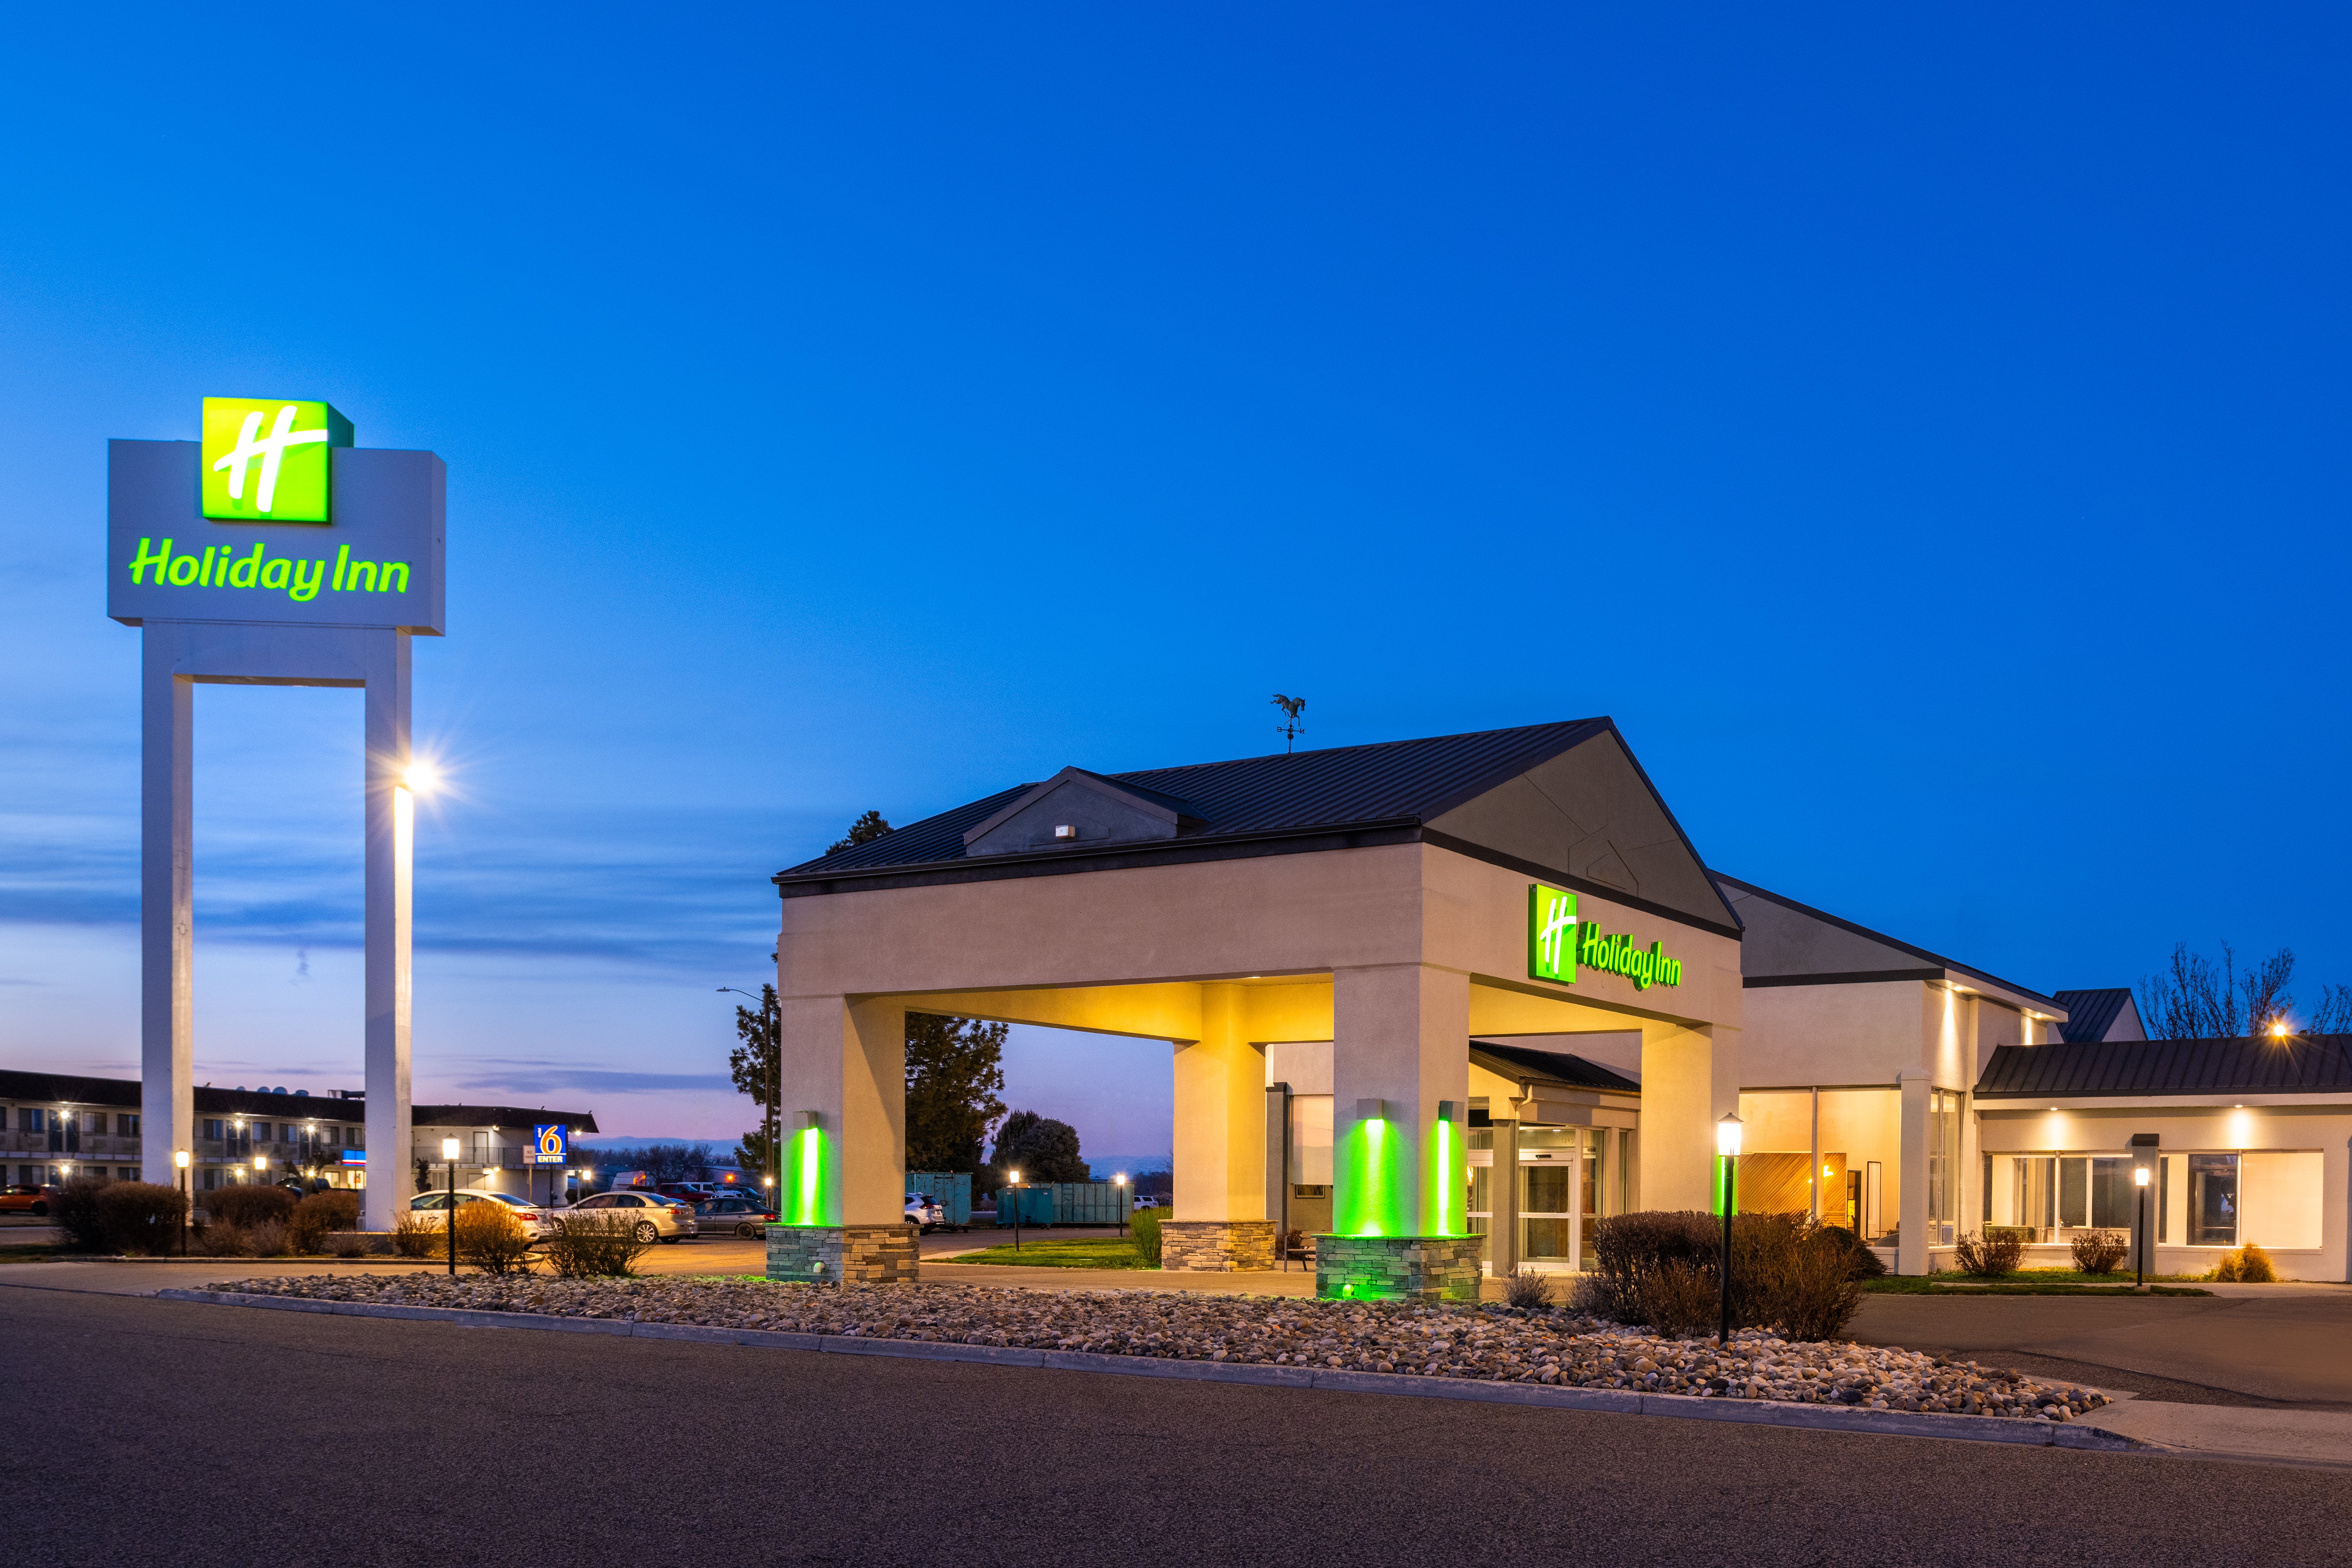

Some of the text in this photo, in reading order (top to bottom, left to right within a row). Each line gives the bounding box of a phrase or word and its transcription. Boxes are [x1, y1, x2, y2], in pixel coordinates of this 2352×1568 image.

[213, 405, 328, 512] H
[128, 537, 409, 602] Holiday Inn
[1540, 896, 1577, 974] H
[1582, 921, 1682, 989] Holiday Inn
[540, 1125, 562, 1155] 6
